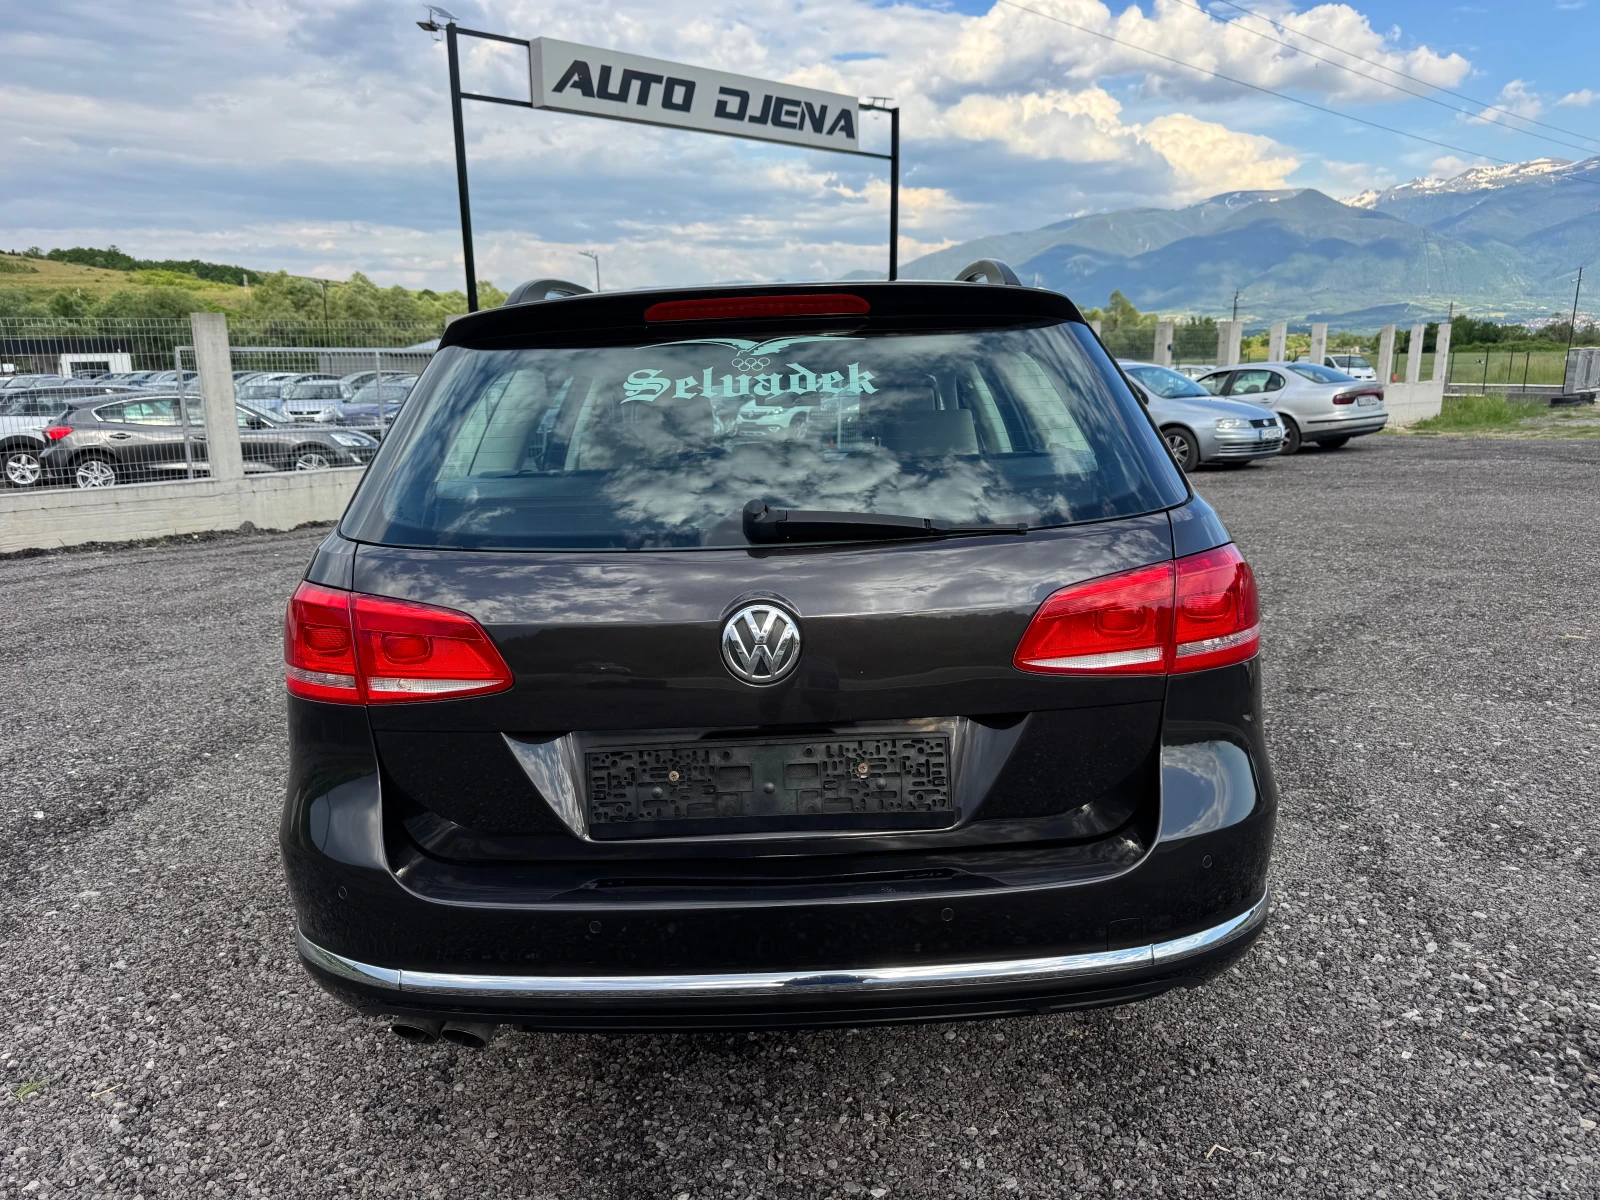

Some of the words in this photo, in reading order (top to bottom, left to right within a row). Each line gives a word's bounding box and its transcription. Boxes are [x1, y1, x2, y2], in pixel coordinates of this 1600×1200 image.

[551, 59, 697, 113] AUTO
[713, 86, 856, 140] DJENA
[722, 604, 801, 683] VW
